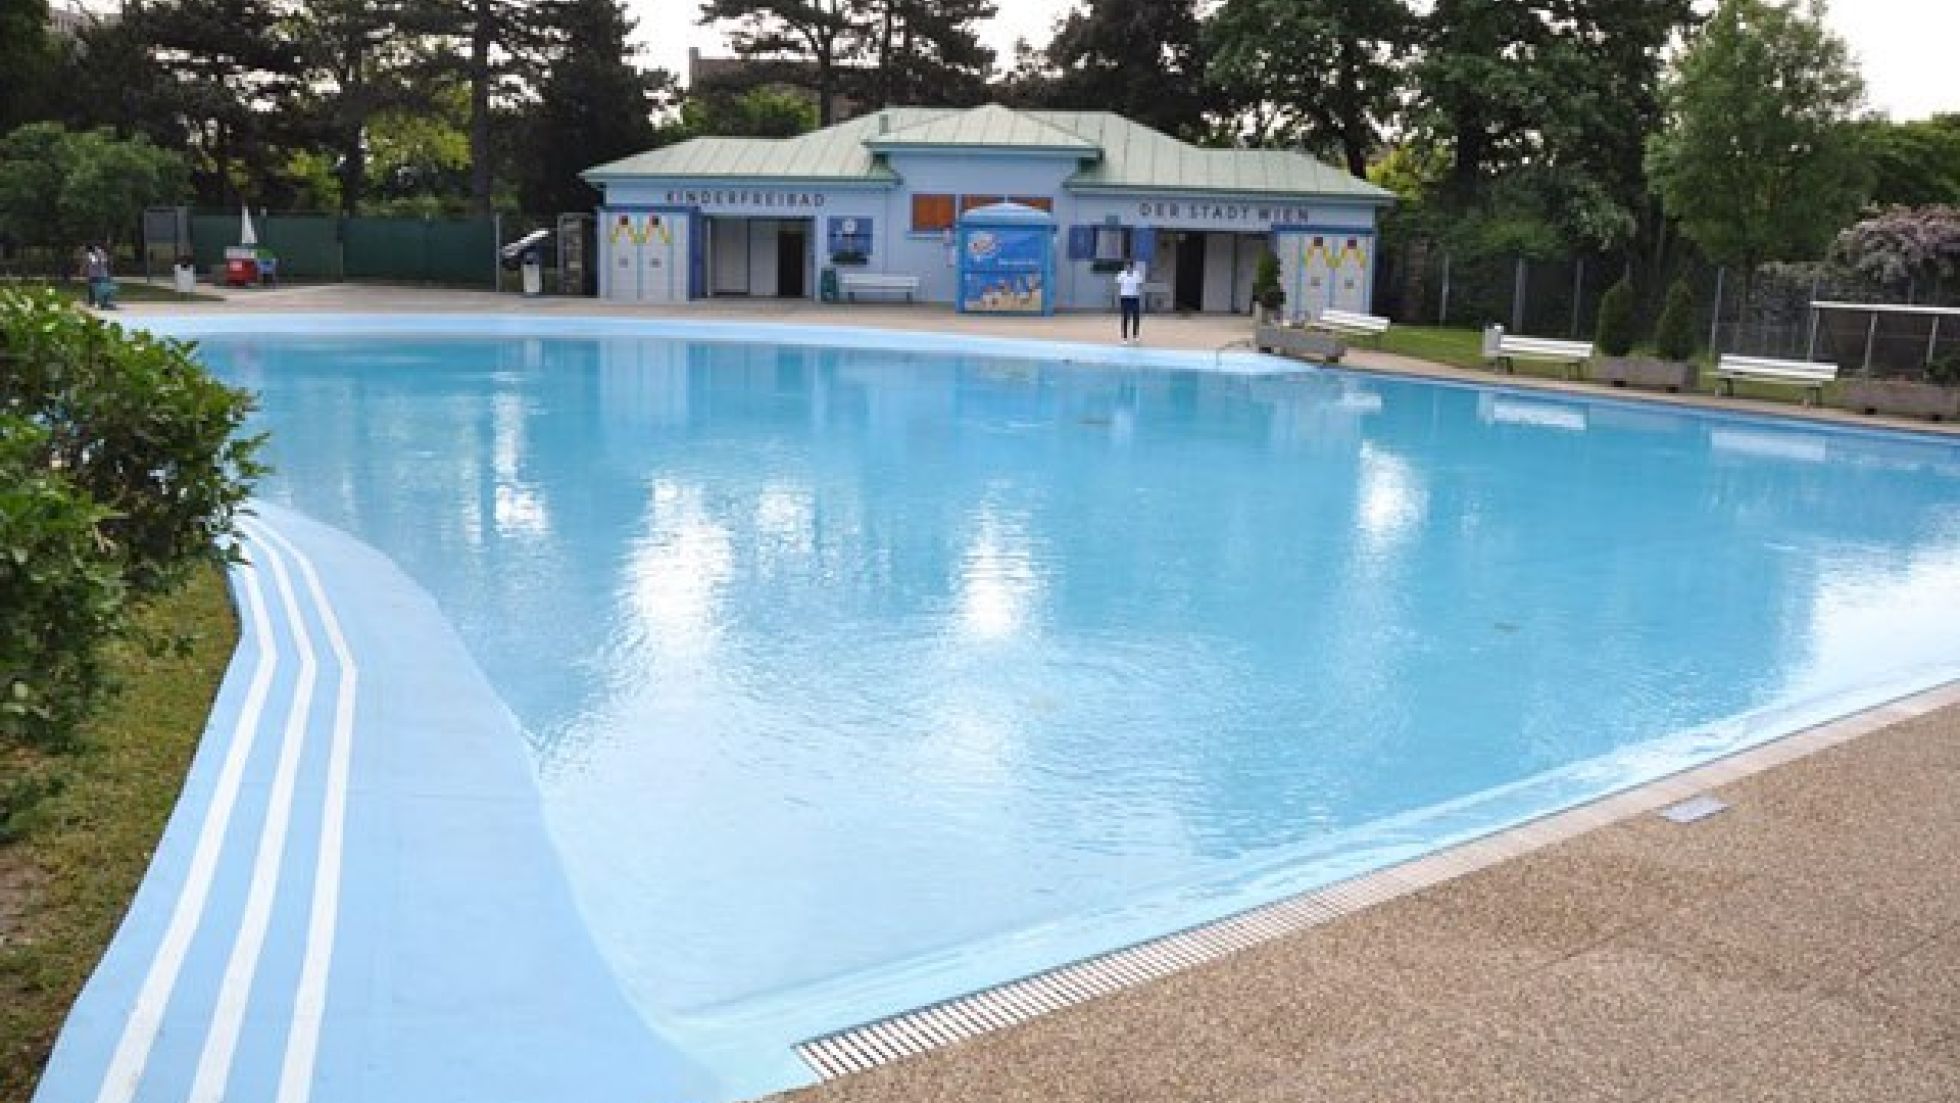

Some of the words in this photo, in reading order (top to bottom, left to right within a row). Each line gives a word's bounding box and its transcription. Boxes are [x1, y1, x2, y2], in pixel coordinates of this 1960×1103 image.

[666, 190, 825, 207] KINDERFREIBAD
[1139, 202, 1180, 218] DER
[1189, 203, 1250, 220] STADT
[1258, 207, 1309, 223] WIEN
